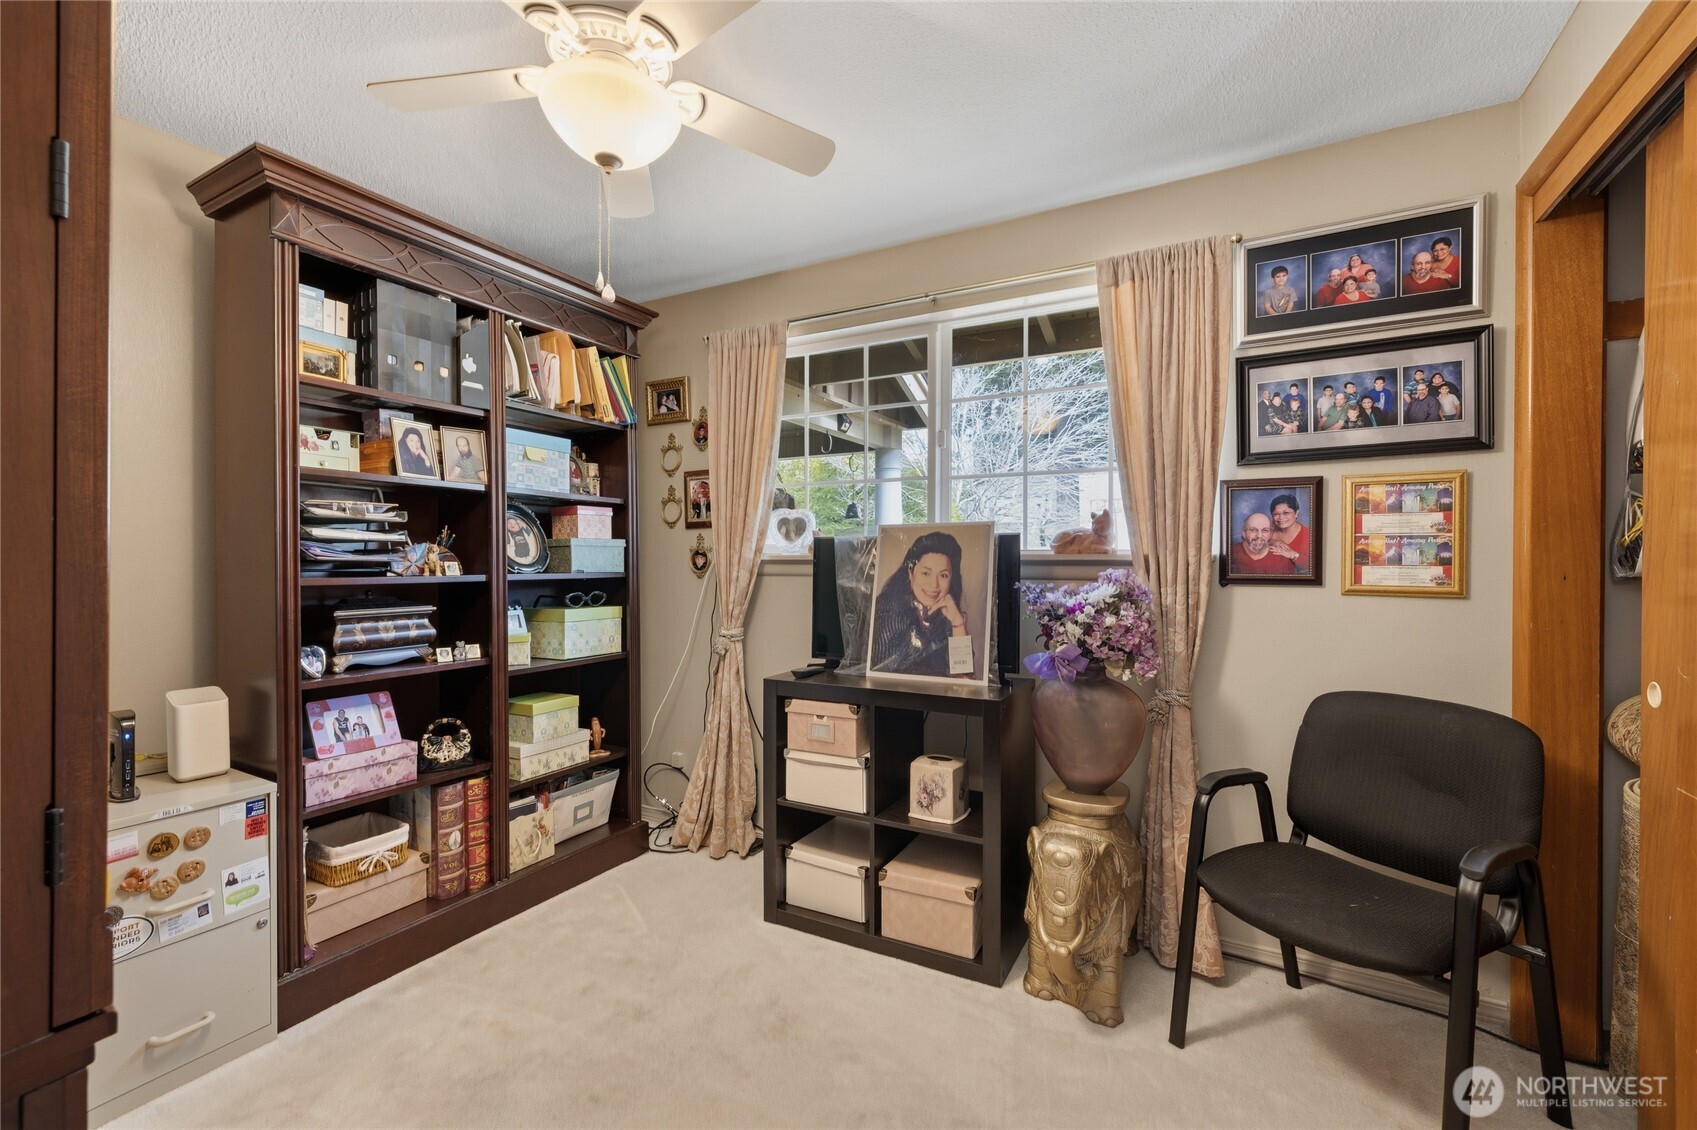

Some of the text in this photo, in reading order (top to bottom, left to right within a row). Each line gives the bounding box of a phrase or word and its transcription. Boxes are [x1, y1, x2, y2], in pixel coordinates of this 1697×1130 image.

[113, 922, 140, 934] PORT
[112, 929, 140, 942] NDED
[112, 936, 141, 949] RIORS
